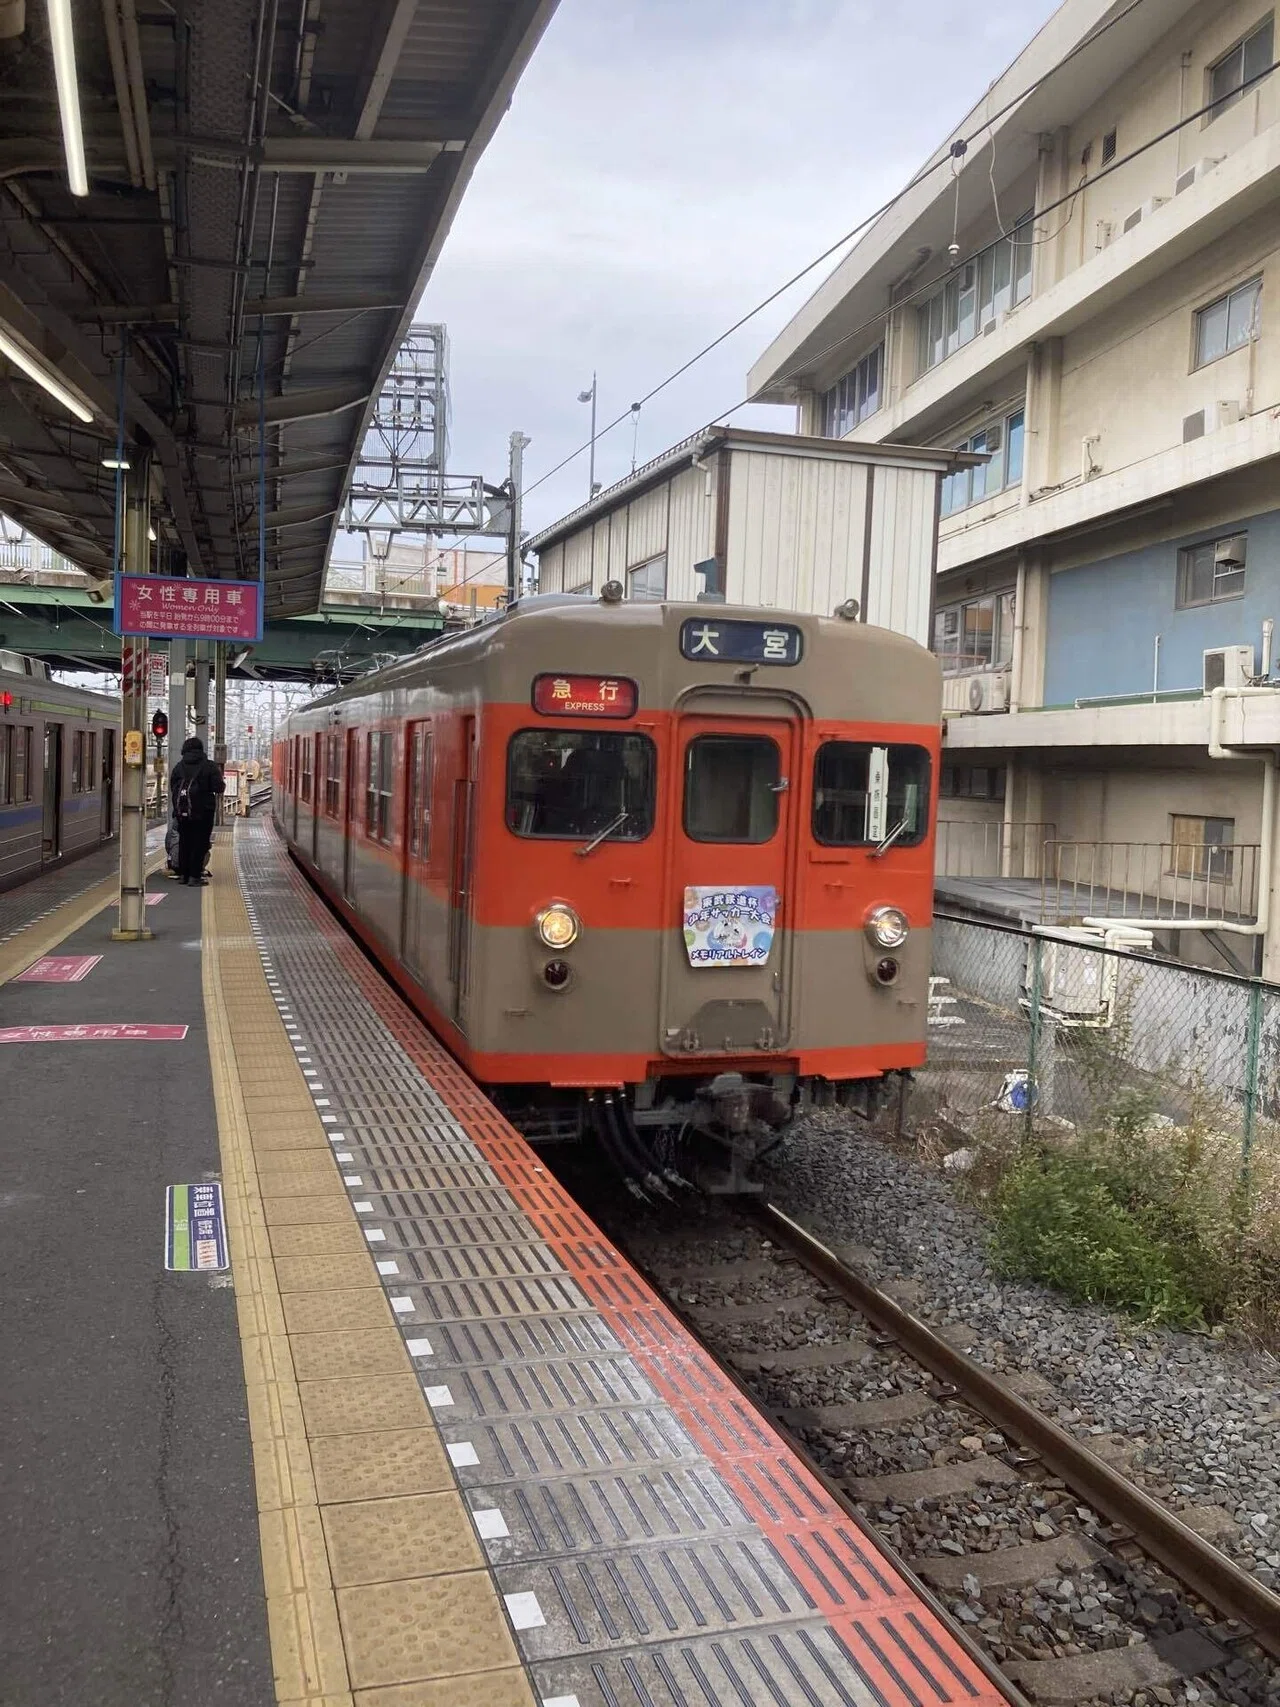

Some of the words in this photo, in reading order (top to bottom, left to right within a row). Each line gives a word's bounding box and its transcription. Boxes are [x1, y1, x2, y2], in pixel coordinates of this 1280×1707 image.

[137, 584, 243, 606] 女性専用車
[162, 603, 199, 612] Women
[197, 604, 220, 614] Only
[691, 624, 789, 660] 大宮
[552, 679, 619, 701] 急行
[565, 702, 605, 712] EXPRESS
[701, 893, 759, 909] 東武鉄道杯
[688, 906, 772, 926] 少年サッカー大会
[691, 948, 767, 960] メモリアルトレイン
